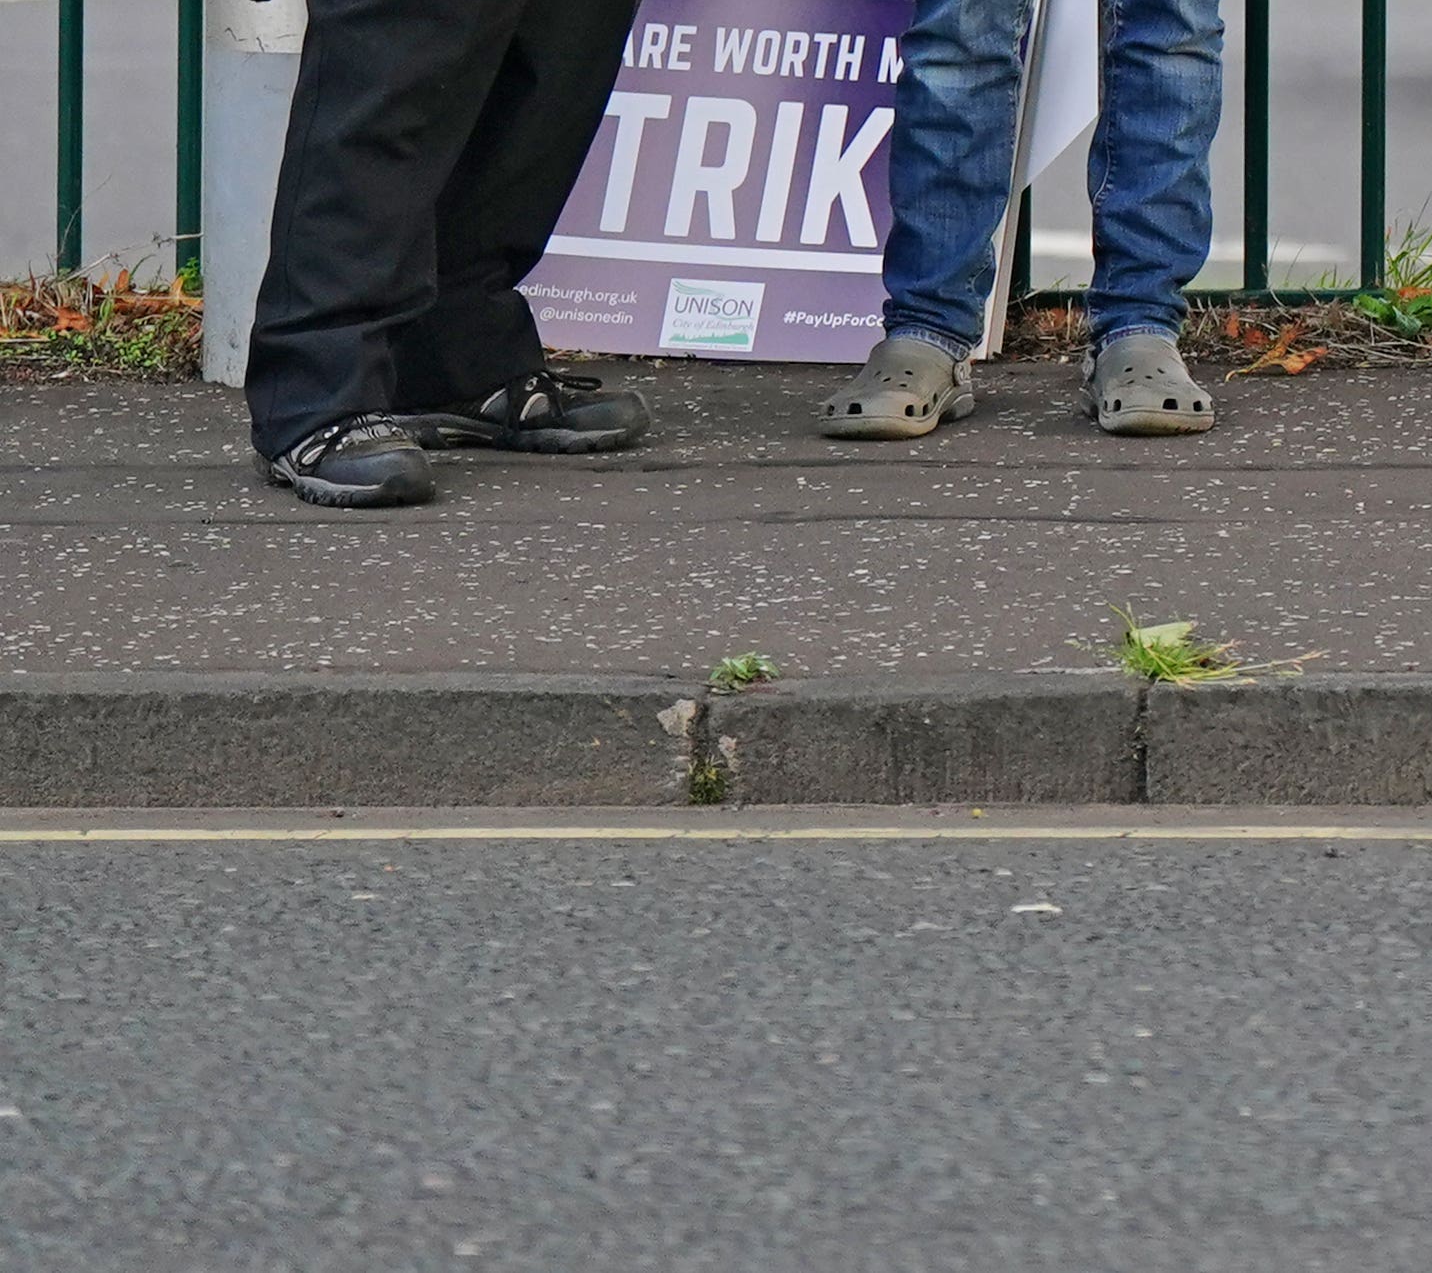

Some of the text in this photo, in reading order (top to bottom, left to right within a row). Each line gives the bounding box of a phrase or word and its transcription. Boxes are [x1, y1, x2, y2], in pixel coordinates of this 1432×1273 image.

[714, 27, 865, 80] WORTH
[600, 91, 894, 247] TRIK
[540, 307, 633, 324] @unisonedin
[675, 297, 753, 317] UNISON
